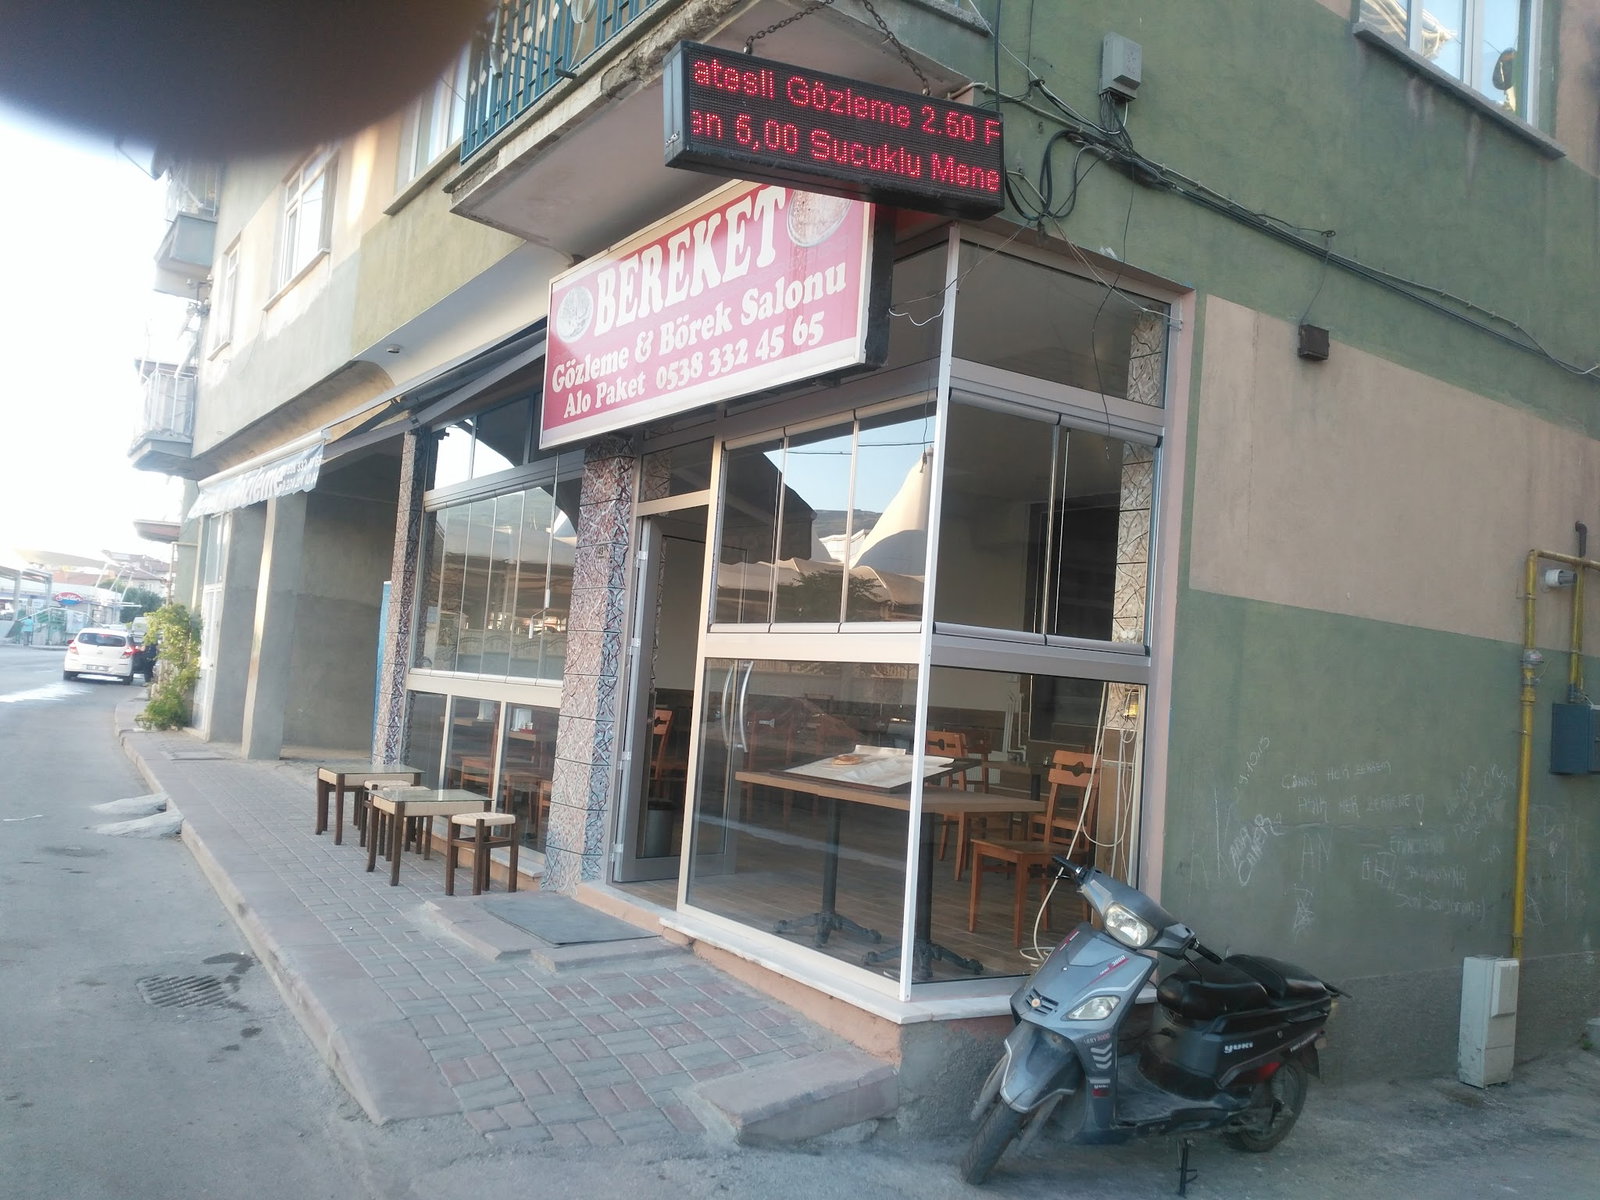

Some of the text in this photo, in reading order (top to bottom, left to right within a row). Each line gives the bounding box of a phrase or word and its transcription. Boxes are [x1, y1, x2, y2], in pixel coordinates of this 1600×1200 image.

[735, 113, 799, 153] 6,00
[810, 129, 921, 179] Sucuklu
[931, 152, 1001, 193] Mene
[786, 75, 911, 128] Gözleme
[593, 185, 787, 338] BEREKET
[551, 262, 847, 393] Gözleme & Börek Salonu
[563, 309, 825, 420] Alo Paket 0538 332 45 65
